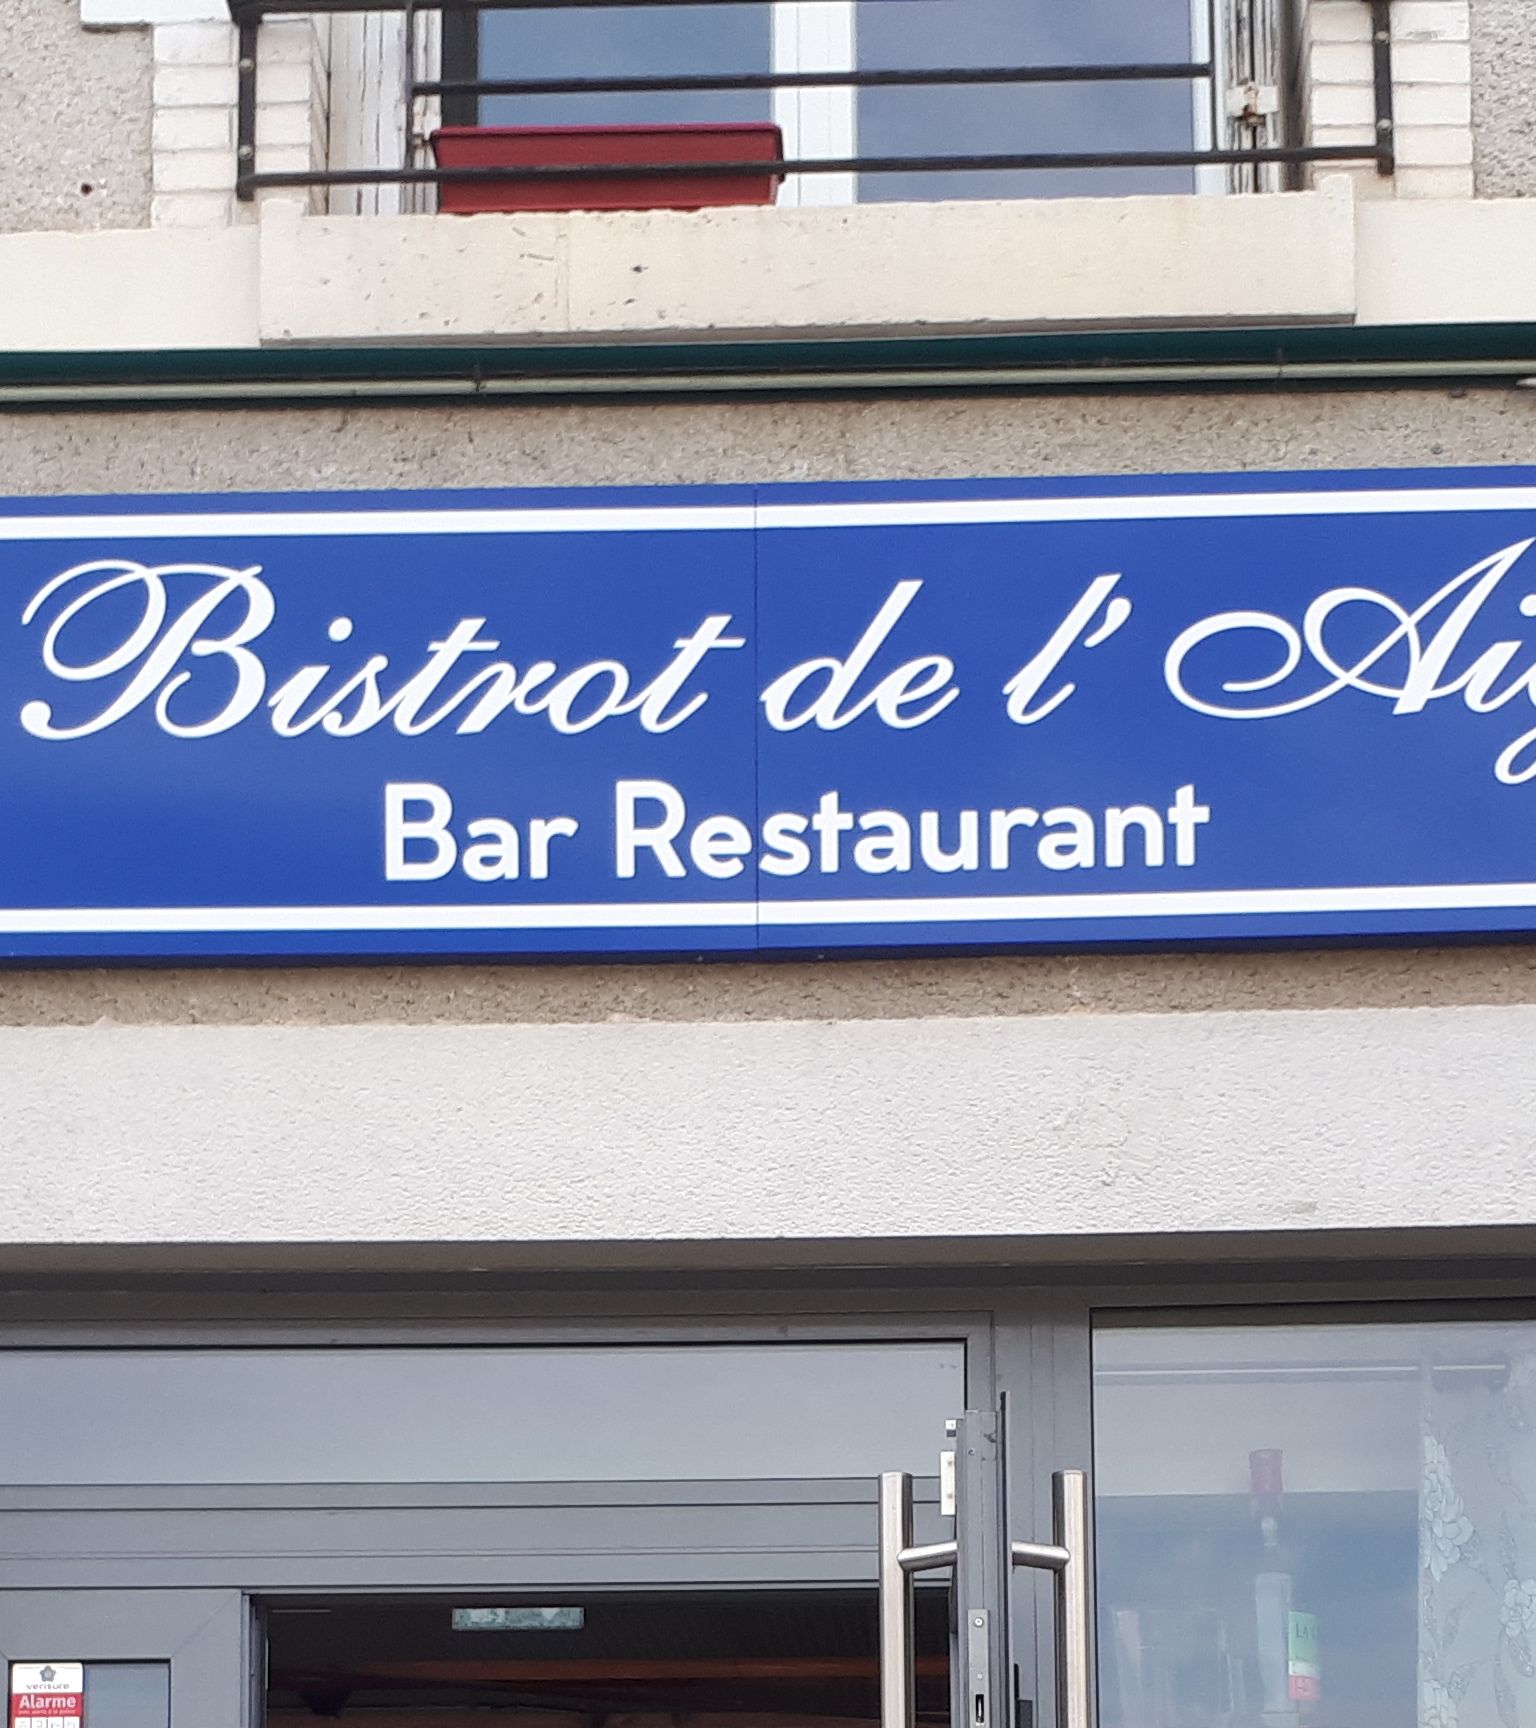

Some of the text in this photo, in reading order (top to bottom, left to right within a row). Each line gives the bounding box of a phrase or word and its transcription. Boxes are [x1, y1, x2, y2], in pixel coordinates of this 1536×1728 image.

[19, 558, 748, 741] Bistrot
[759, 578, 960, 732] de
[1001, 573, 1134, 727] l'
[383, 778, 1213, 883] Bar Restaurant
[19, 1694, 77, 1709] Alarme
